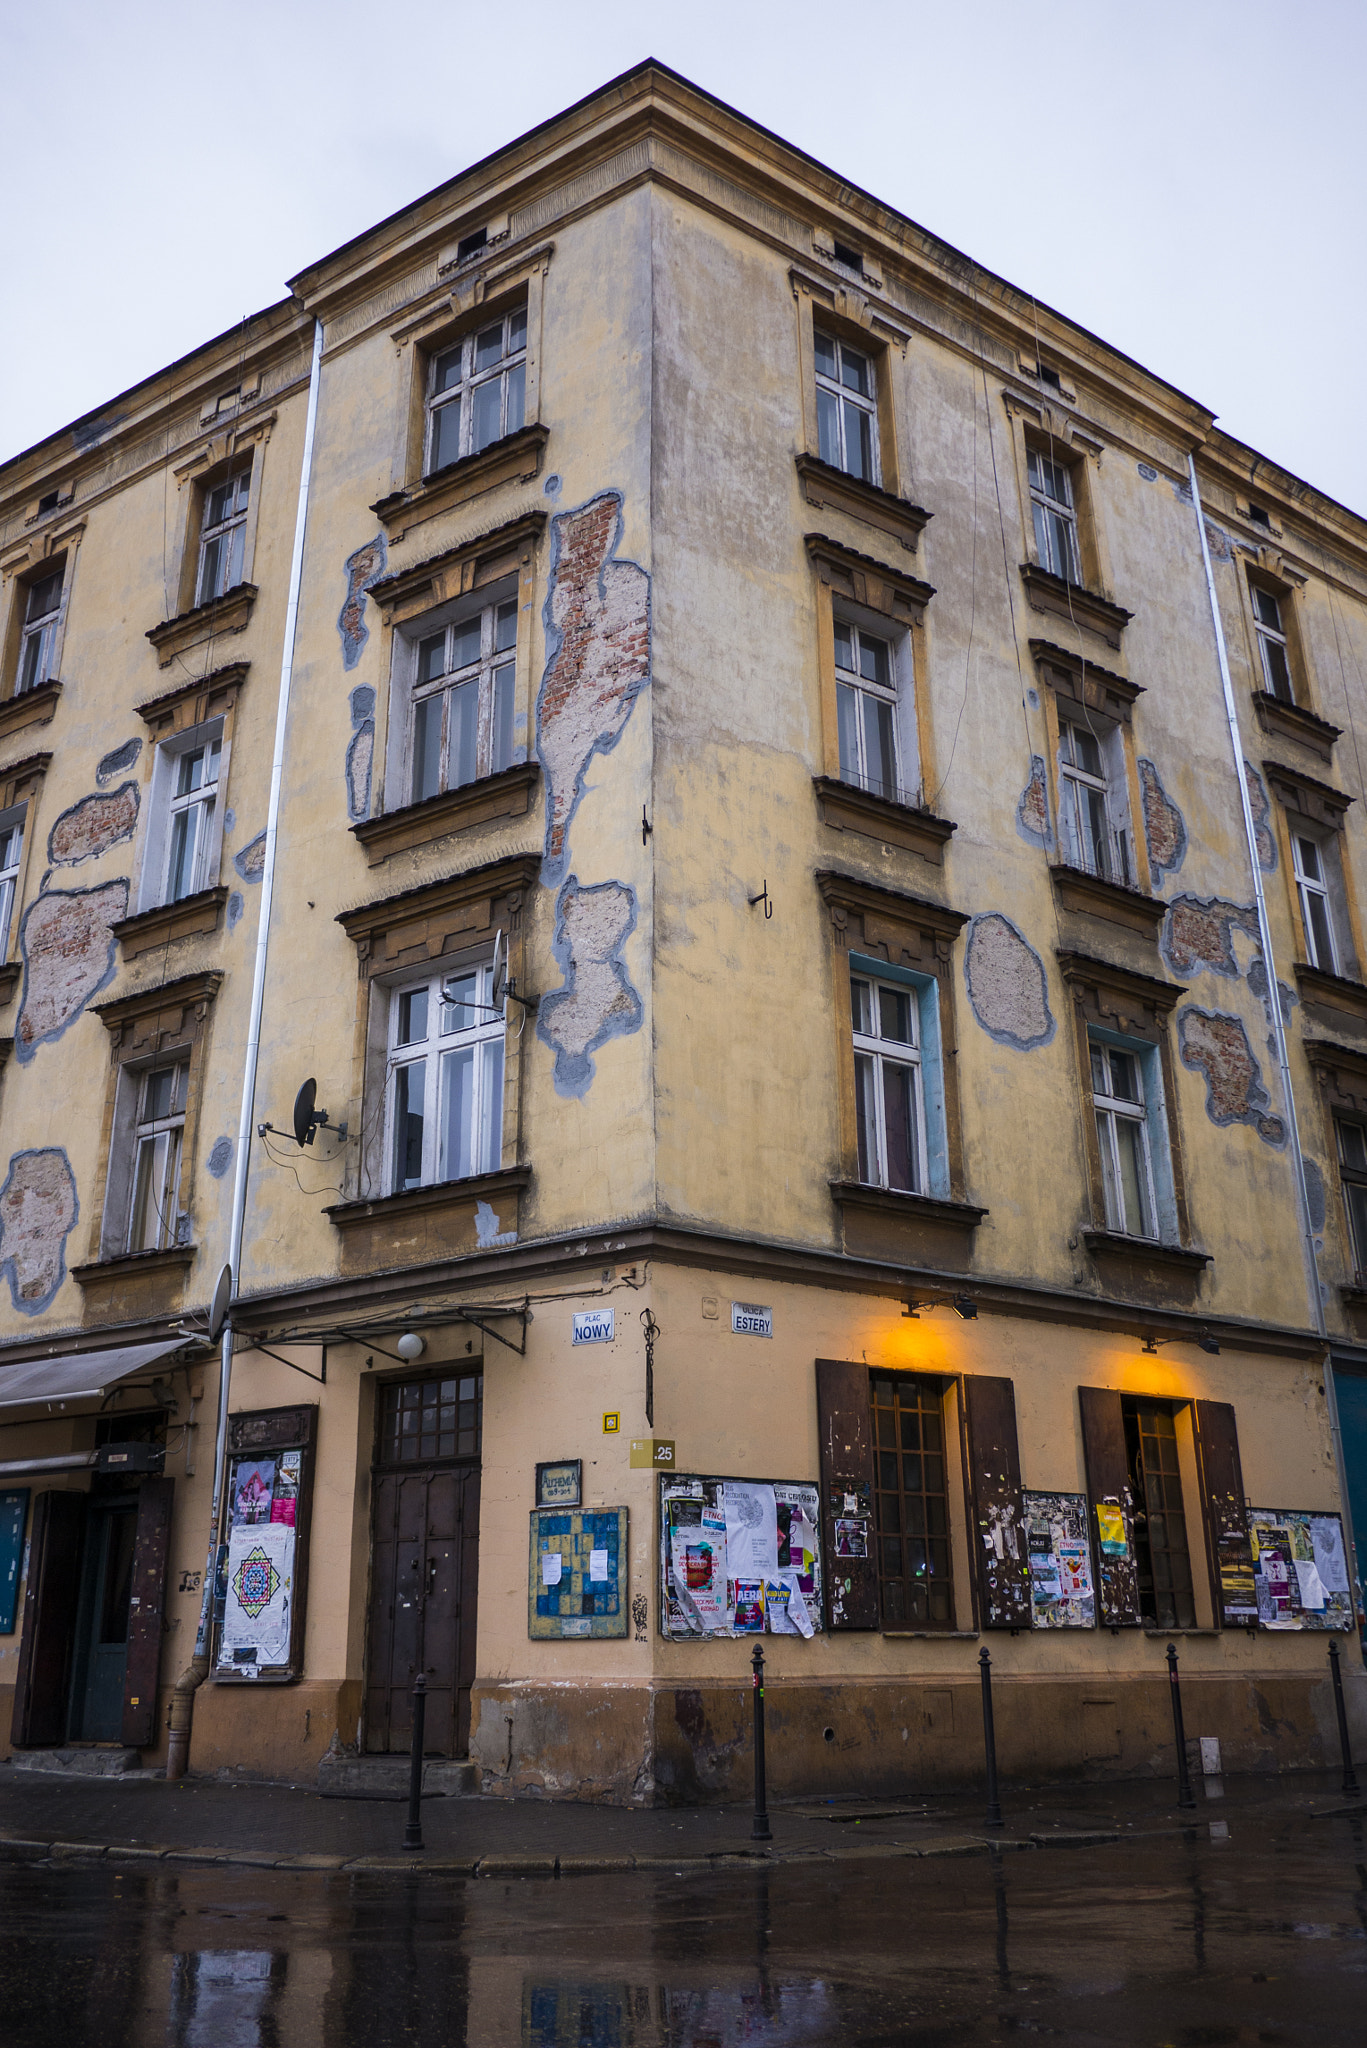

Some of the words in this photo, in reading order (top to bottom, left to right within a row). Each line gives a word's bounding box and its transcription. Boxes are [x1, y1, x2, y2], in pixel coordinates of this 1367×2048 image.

[585, 1314, 601, 1323] PLAC
[736, 1316, 771, 1333] ESTERY
[575, 1323, 611, 1341] NOWY
